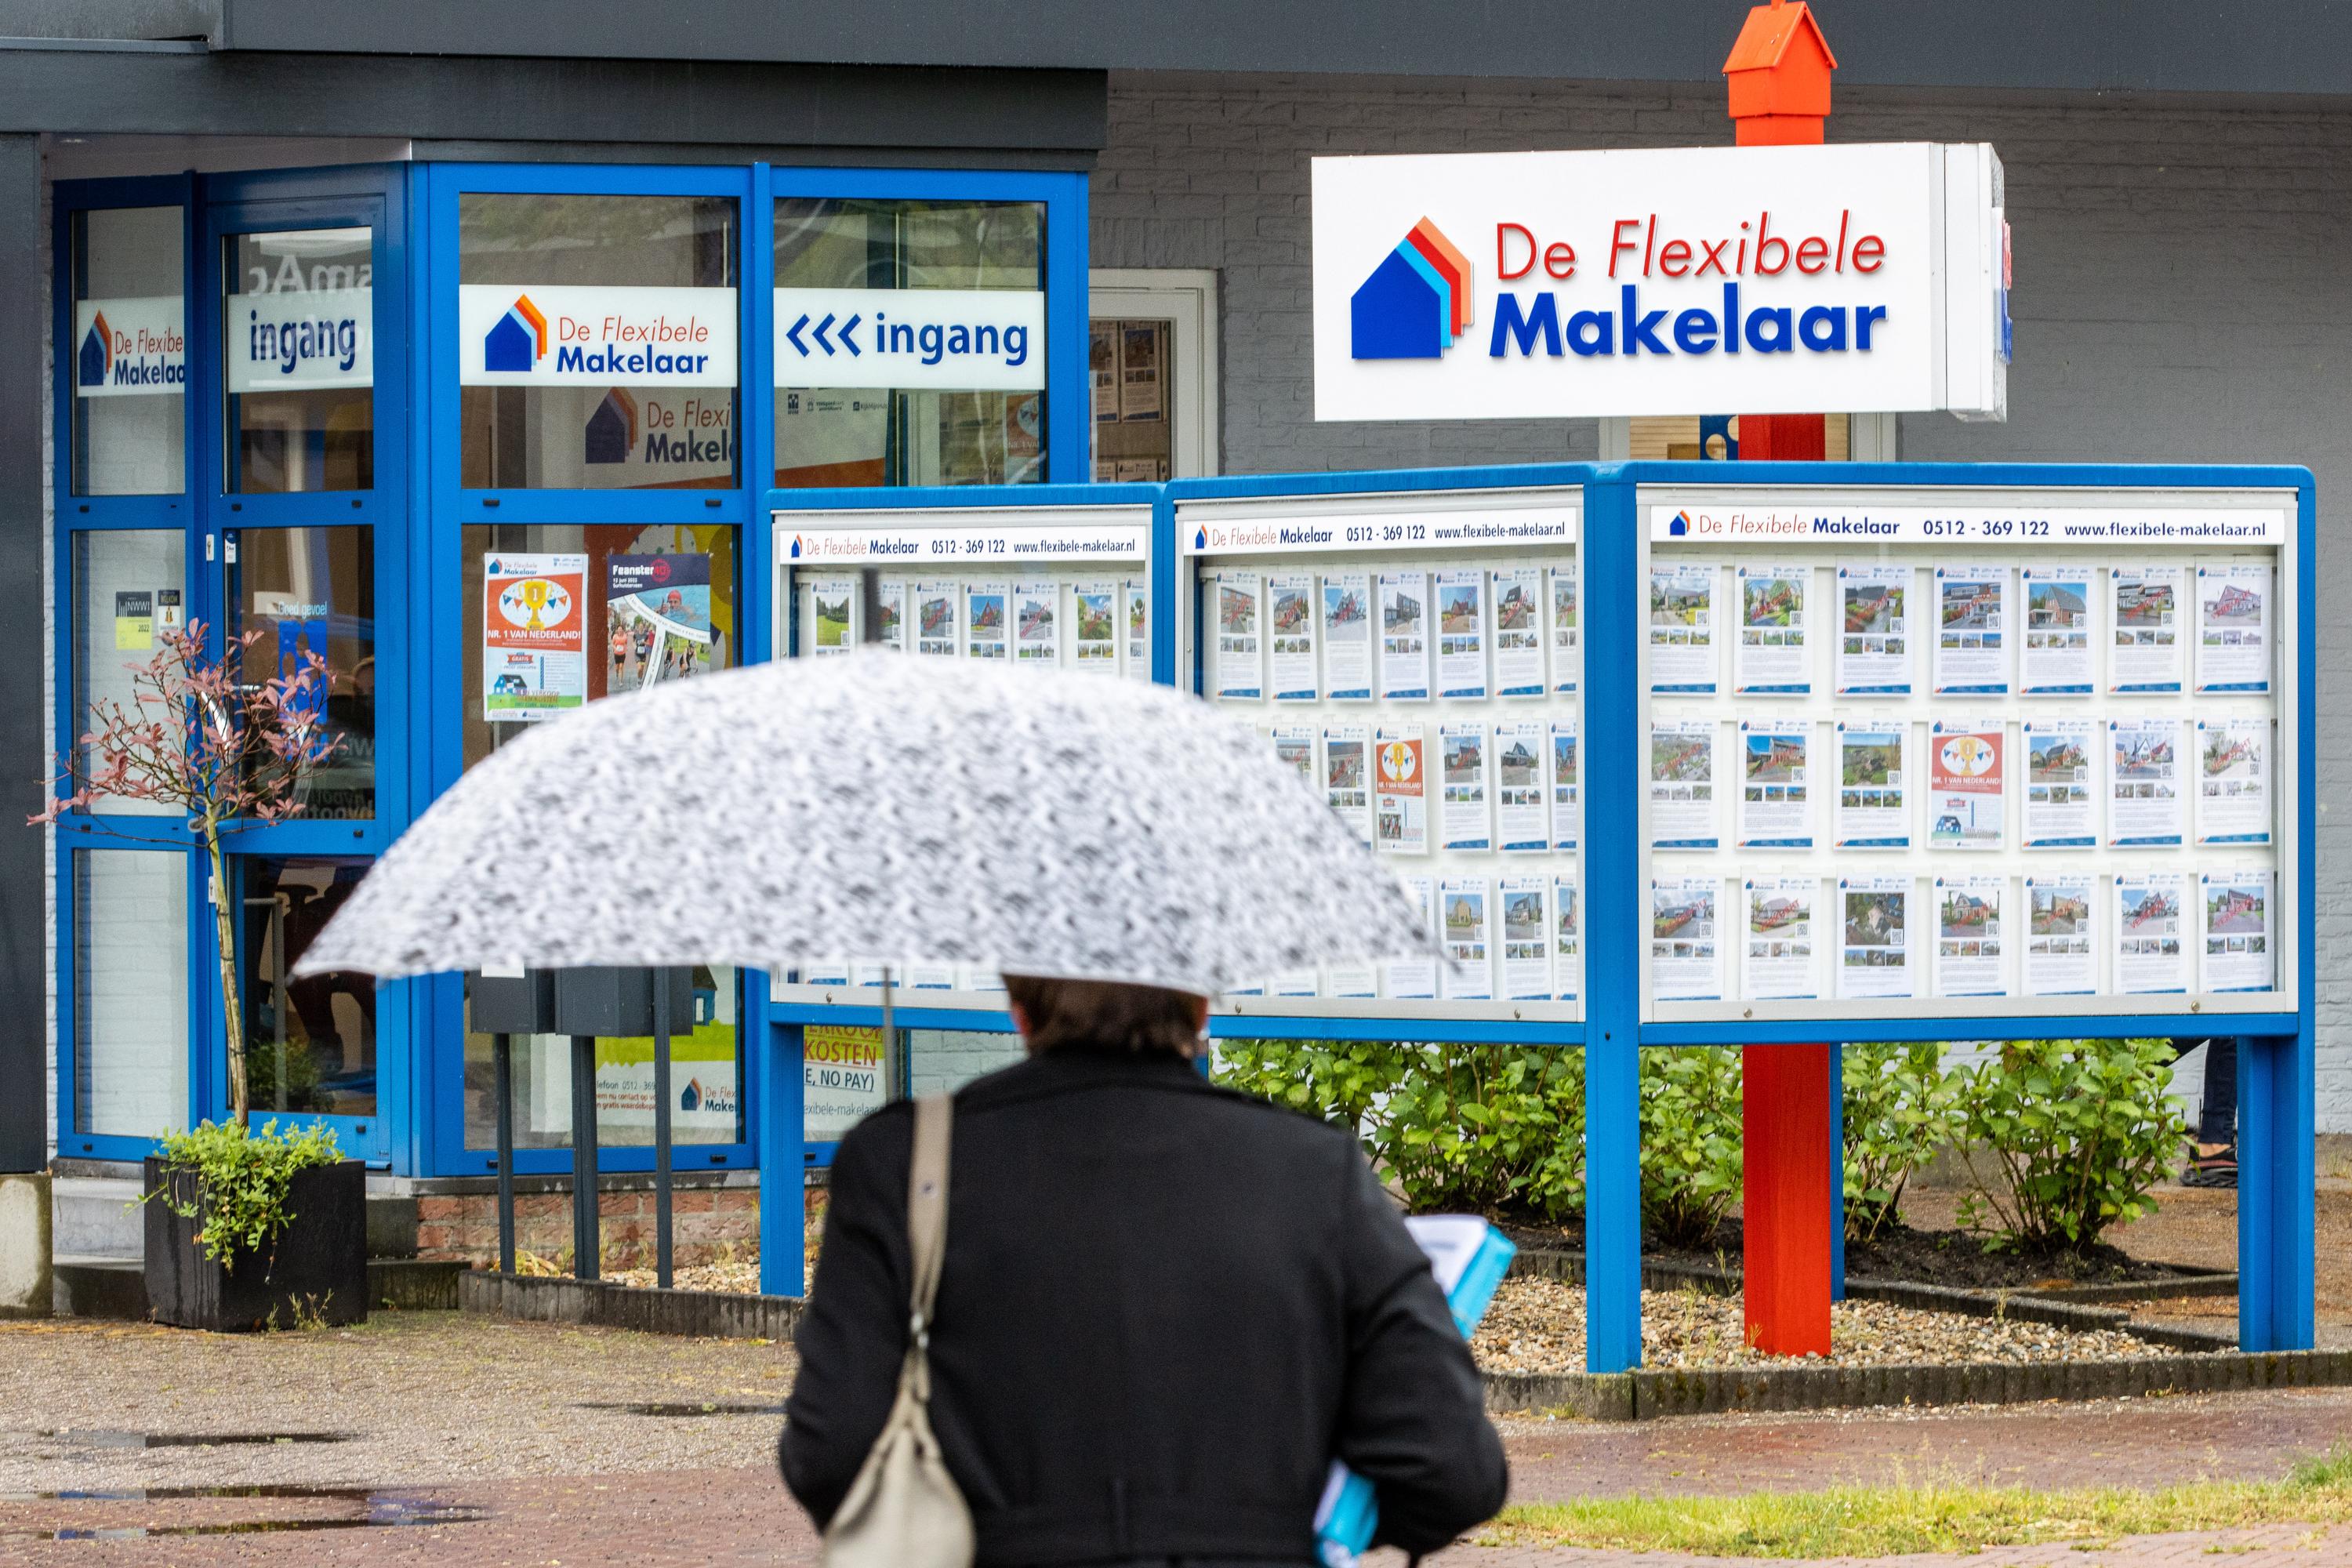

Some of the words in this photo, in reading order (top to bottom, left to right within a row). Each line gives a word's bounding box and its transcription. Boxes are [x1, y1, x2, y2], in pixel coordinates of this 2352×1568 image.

[1497, 222, 1579, 281] De
[1608, 209, 1887, 280] Flexibele
[560, 317, 590, 342] De
[602, 315, 709, 342] Flexibele
[1489, 282, 1889, 358] Makelaar
[115, 330, 132, 354] De
[137, 326, 183, 354] Flexibe
[250, 309, 356, 374] ingang
[876, 312, 1028, 366] ingang
[556, 343, 709, 374] Makelaar
[648, 401, 674, 428] De
[684, 397, 731, 427] Flexi
[1213, 528, 1226, 546] De
[1230, 526, 1277, 546] Flexibele
[1279, 525, 1334, 544] Makelaar
[1346, 526, 1373, 542] 0512
[1383, 525, 1403, 541] 369
[1406, 524, 1425, 540] 122
[1435, 522, 1566, 540] www.flexibele-makelaar.nl
[1700, 514, 1722, 534] De
[1730, 511, 1807, 534] Flexibele
[1812, 515, 1900, 535] Makelaar
[1923, 520, 1965, 535] 0512
[1982, 521, 2013, 535] 369
[2020, 521, 2049, 535] 122
[2064, 521, 2266, 537] www.flexibele-makelaar.nl
[808, 539, 820, 555] De
[824, 537, 866, 555] Flexibele
[869, 538, 919, 554] Makelaar
[931, 539, 956, 554] 0512
[965, 539, 984, 554] 369
[987, 539, 1005, 553] 122
[1013, 538, 1135, 553] www.flexibele-makelaar.nl
[278, 601, 299, 615] Goed
[301, 601, 328, 619] gevoel
[488, 630, 501, 638] NR.
[529, 630, 581, 639] NEDERLAND!
[804, 1040, 877, 1066] KOSTEN
[622, 1080, 638, 1090] 0512
[820, 1069, 840, 1086] NO
[844, 1072, 874, 1092] PAY)
[705, 1098, 735, 1112] Make
